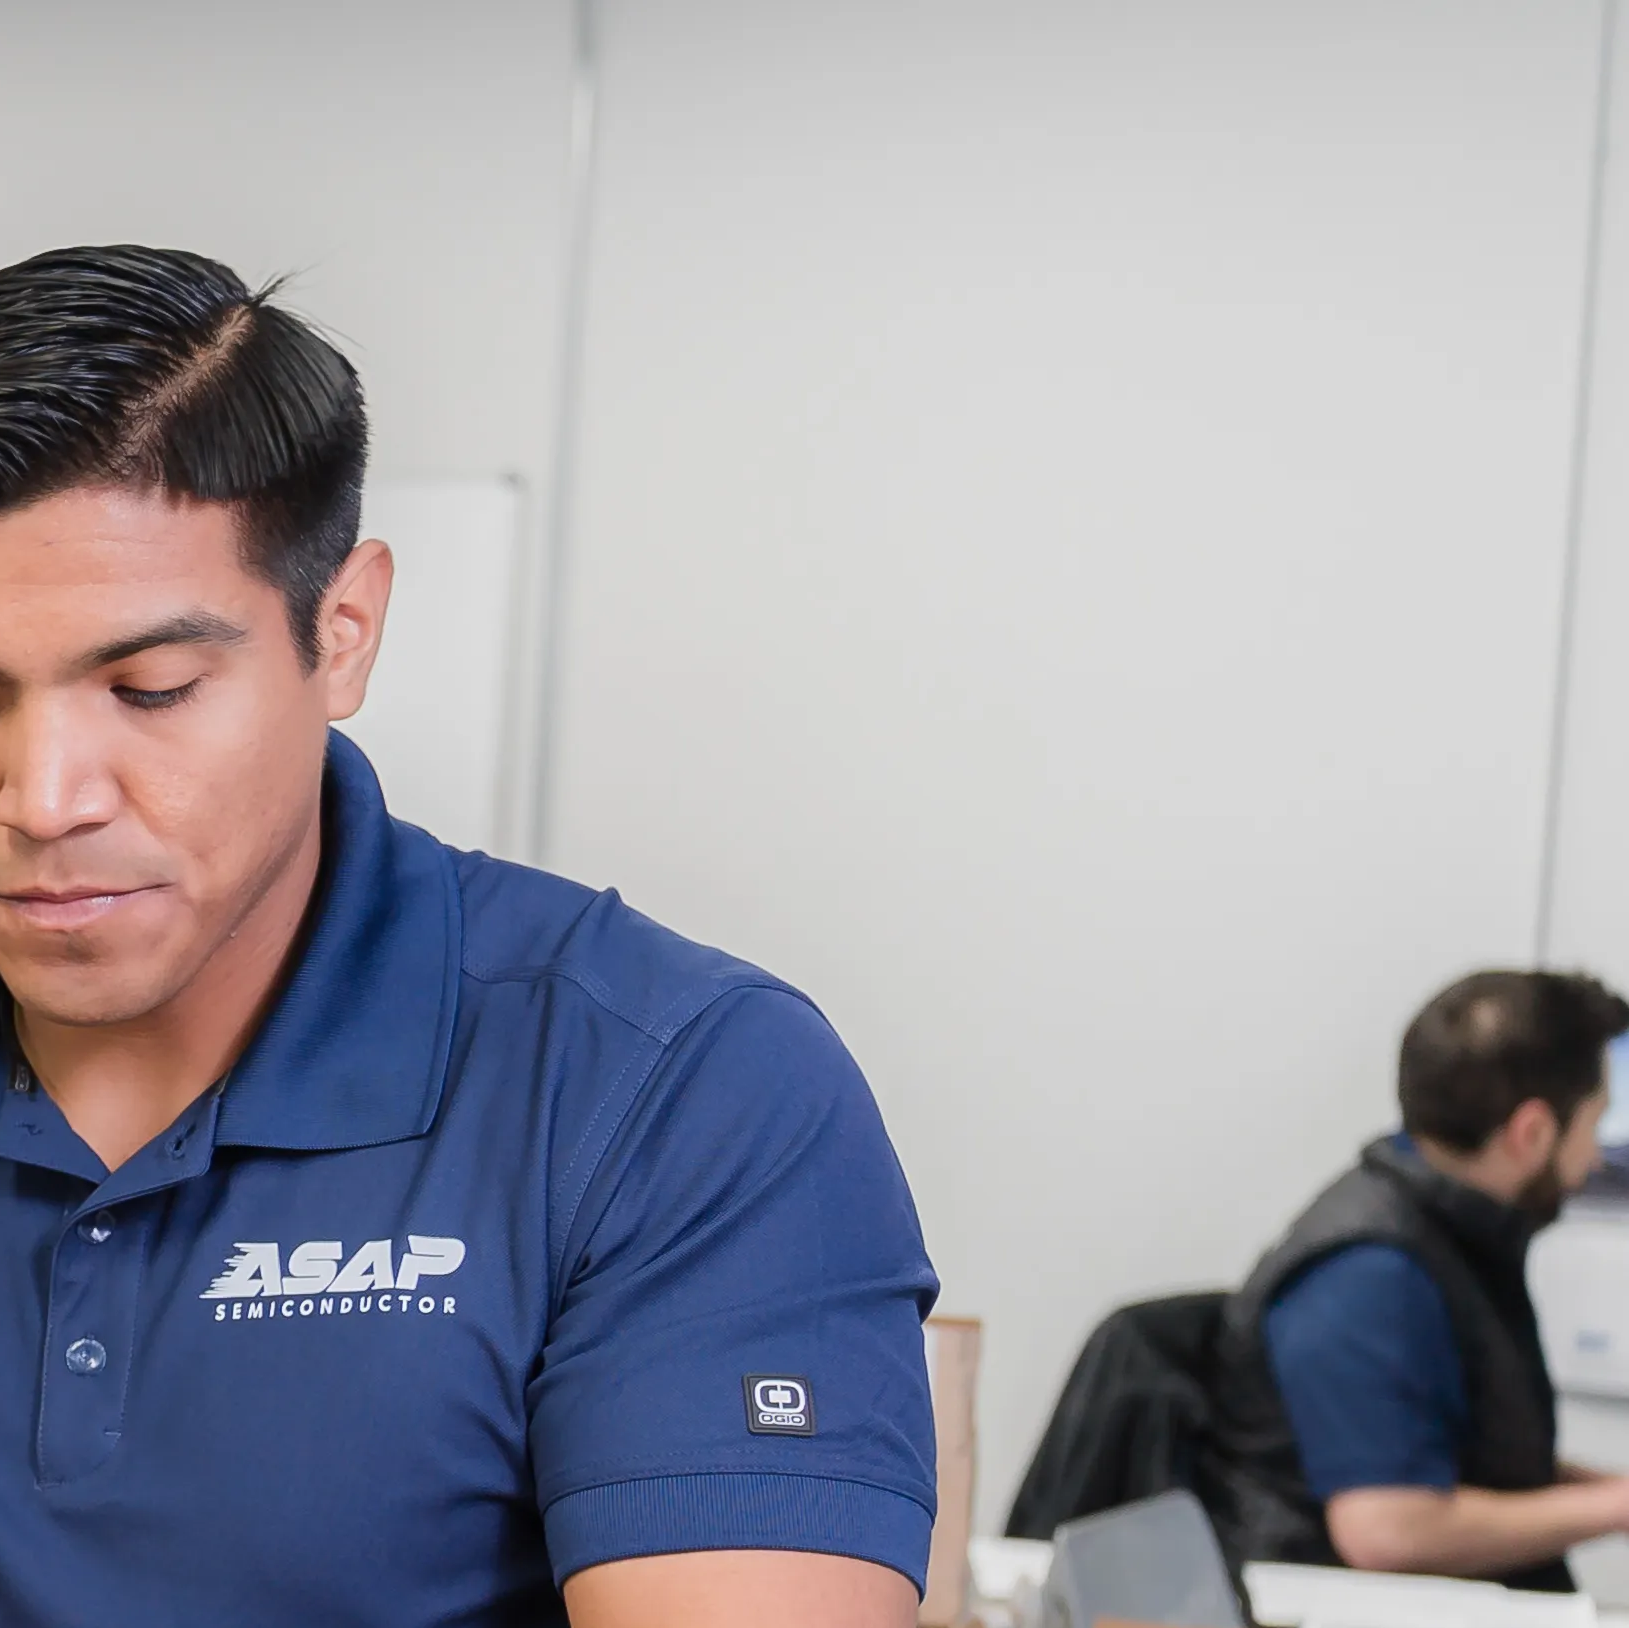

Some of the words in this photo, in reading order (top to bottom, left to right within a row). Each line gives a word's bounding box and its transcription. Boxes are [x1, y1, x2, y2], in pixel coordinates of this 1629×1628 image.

[199, 1234, 466, 1298] ASAP
[214, 1294, 457, 1321] SEMICONDUCTOR
[759, 1412, 805, 1426] OGIO
